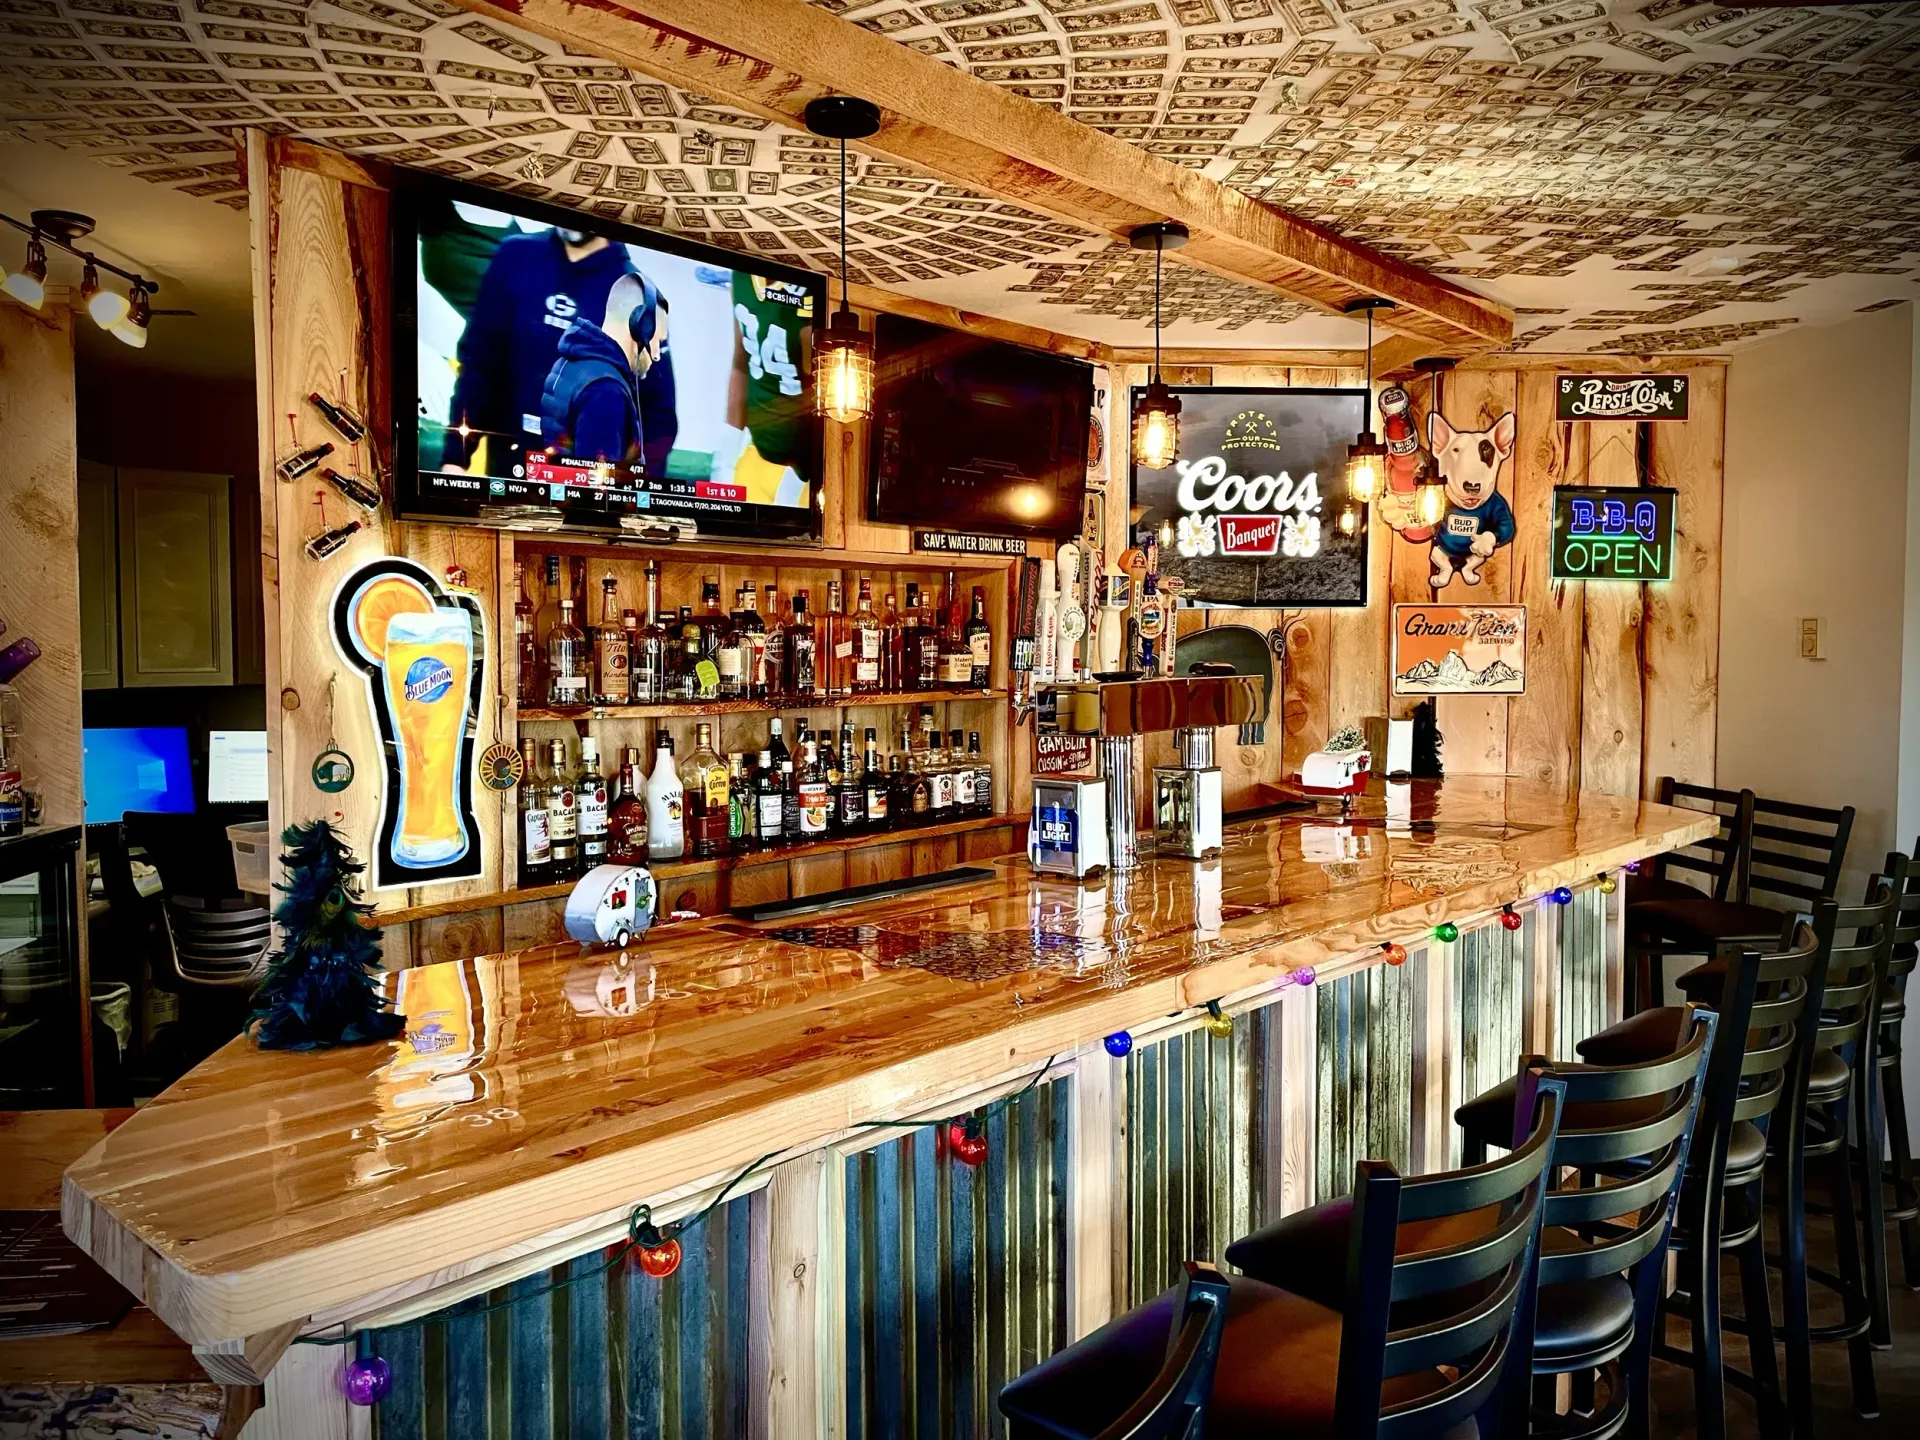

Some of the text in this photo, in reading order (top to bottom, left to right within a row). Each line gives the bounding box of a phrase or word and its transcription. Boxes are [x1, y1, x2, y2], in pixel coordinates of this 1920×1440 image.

[1226, 410, 1277, 437] PROTECT
[1221, 441, 1281, 451] PROTECTORS
[529, 454, 546, 463] 4/52
[629, 465, 644, 474] 4/31
[433, 478, 636, 503] NFL WEEK 15 NYJ 0 MIA 27 3RD 8:14
[542, 470, 553, 479] TB
[575, 473, 587, 483] 20
[604, 477, 615, 486] GB
[635, 479, 645, 488] 17
[649, 482, 662, 491] 3RD
[670, 484, 686, 493] 1:35
[706, 487, 718, 496] 1ST
[720, 488, 726, 497] &
[727, 489, 737, 498] 10
[1175, 456, 1323, 512] Coors
[734, 505, 742, 513] TD
[1450, 525, 1474, 533] LIGHT
[1454, 518, 1472, 526] BUD
[923, 533, 1025, 554] SAVE WATER DRINK BEER
[1226, 520, 1277, 549] Banquet
[1564, 543, 1661, 573] OPEN
[1405, 613, 1468, 637] Grand
[406, 669, 452, 701] BLUE MOON
[1042, 830, 1070, 841] LIGHT
[1045, 822, 1066, 832] BUD
